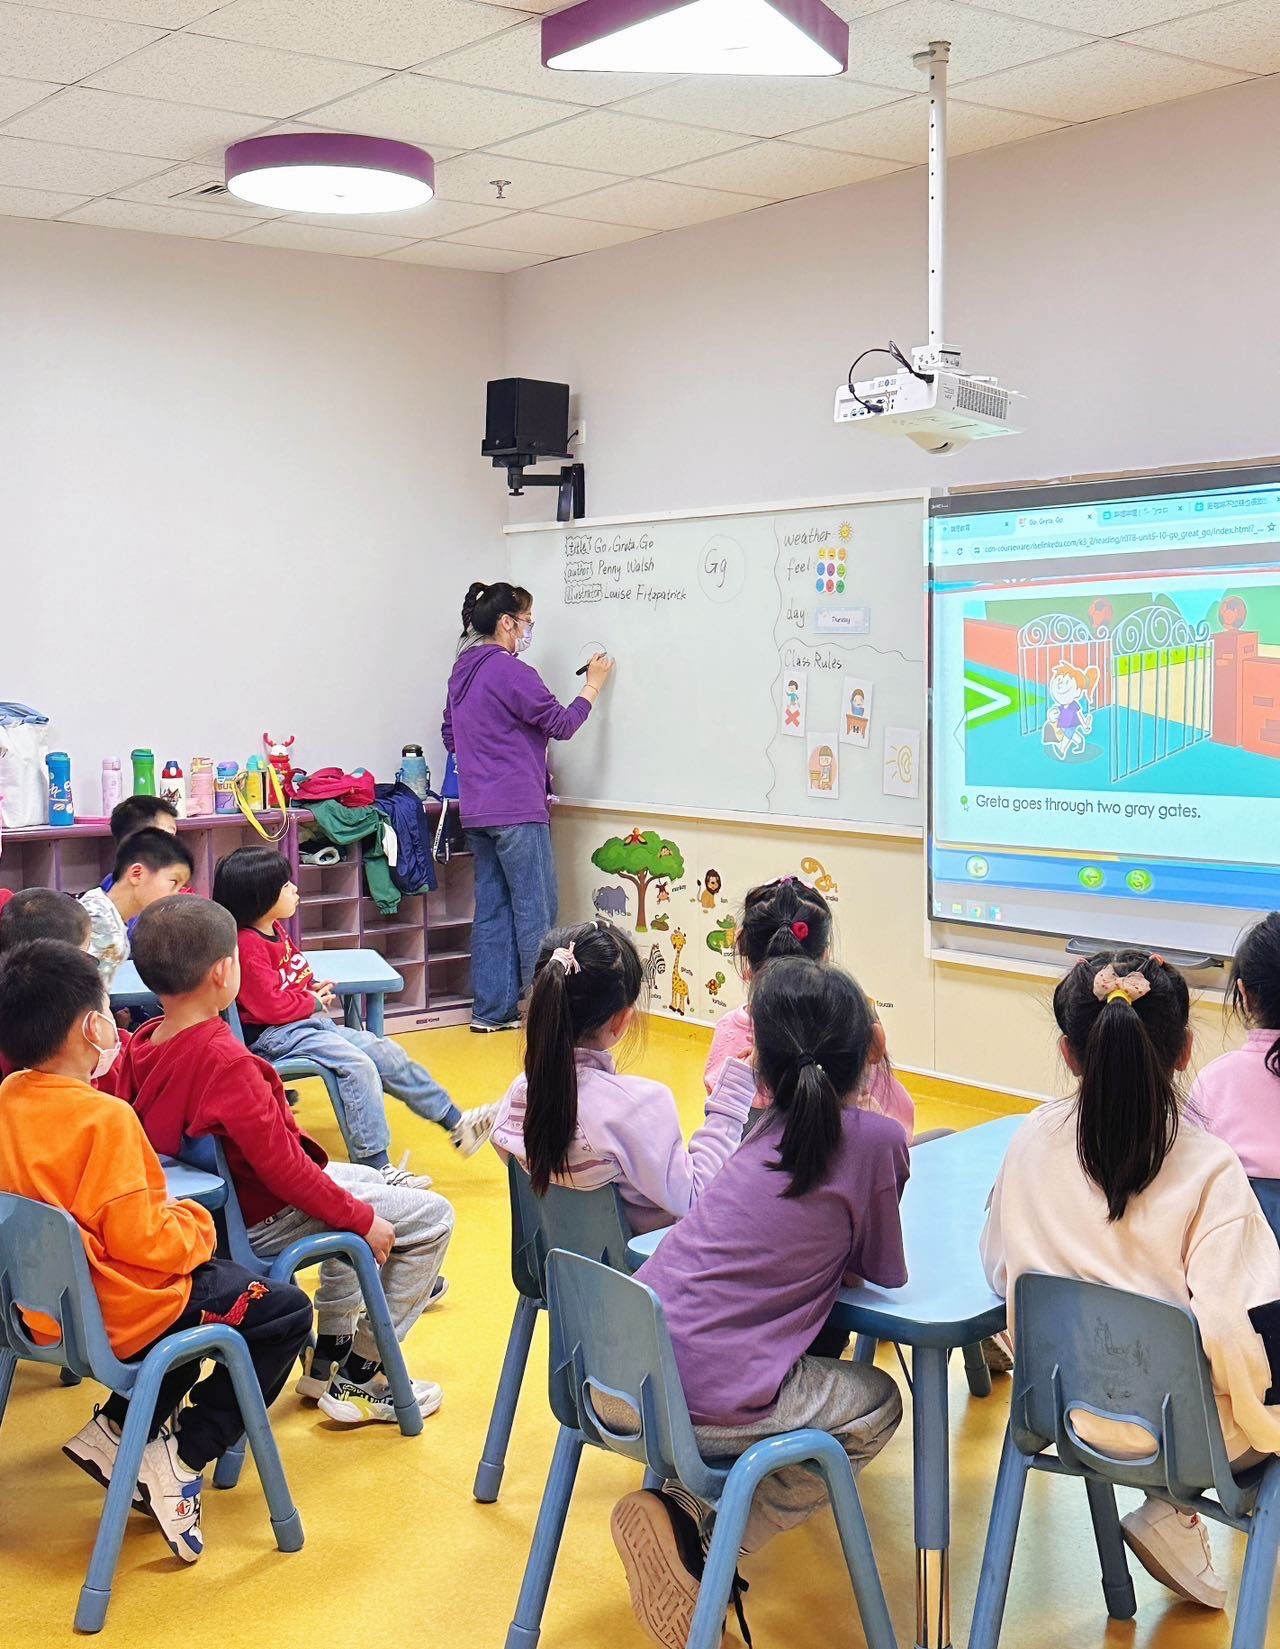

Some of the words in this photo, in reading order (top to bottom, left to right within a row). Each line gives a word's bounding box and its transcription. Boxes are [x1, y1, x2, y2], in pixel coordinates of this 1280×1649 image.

[639, 533, 655, 549] Go
[783, 527, 831, 547] weather
[567, 563, 590, 577] author
[598, 559, 621, 582] Penny
[627, 556, 655, 573] Walsh
[603, 585, 632, 600] Louise
[636, 584, 687, 611] Fitzpatrick
[786, 598, 807, 628] day
[784, 650, 811, 668] Class
[814, 651, 842, 670] Rules
[975, 794, 1010, 809] Greta
[1012, 798, 1042, 814] goes
[1045, 797, 1094, 815] through
[1097, 800, 1121, 815] two
[1124, 804, 1155, 819] gray
[1158, 803, 1202, 820] gates.
